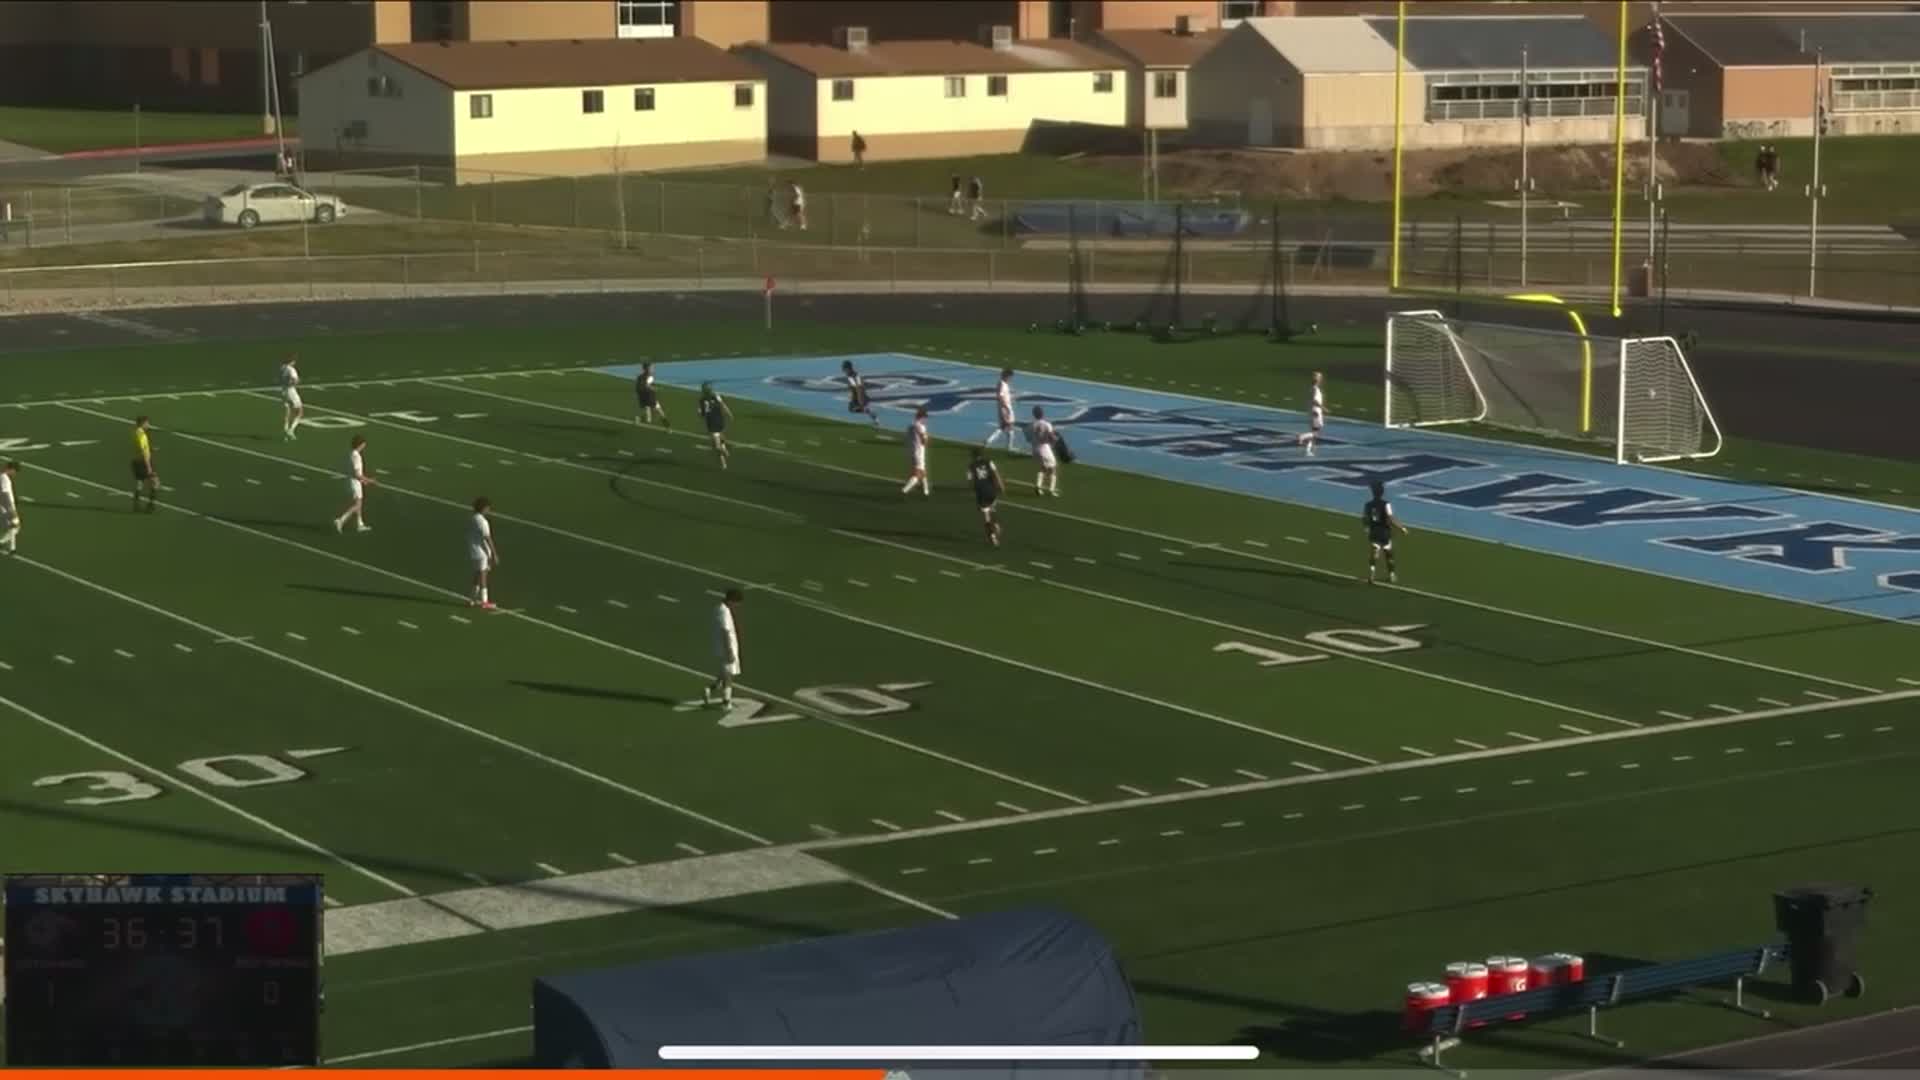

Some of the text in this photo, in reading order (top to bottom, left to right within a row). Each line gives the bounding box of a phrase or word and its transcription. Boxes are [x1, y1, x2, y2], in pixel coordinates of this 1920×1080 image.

[759, 371, 1920, 597] SKYHAWK
[1212, 628, 1422, 667] 10
[672, 683, 913, 729] 20
[33, 752, 310, 806] 30
